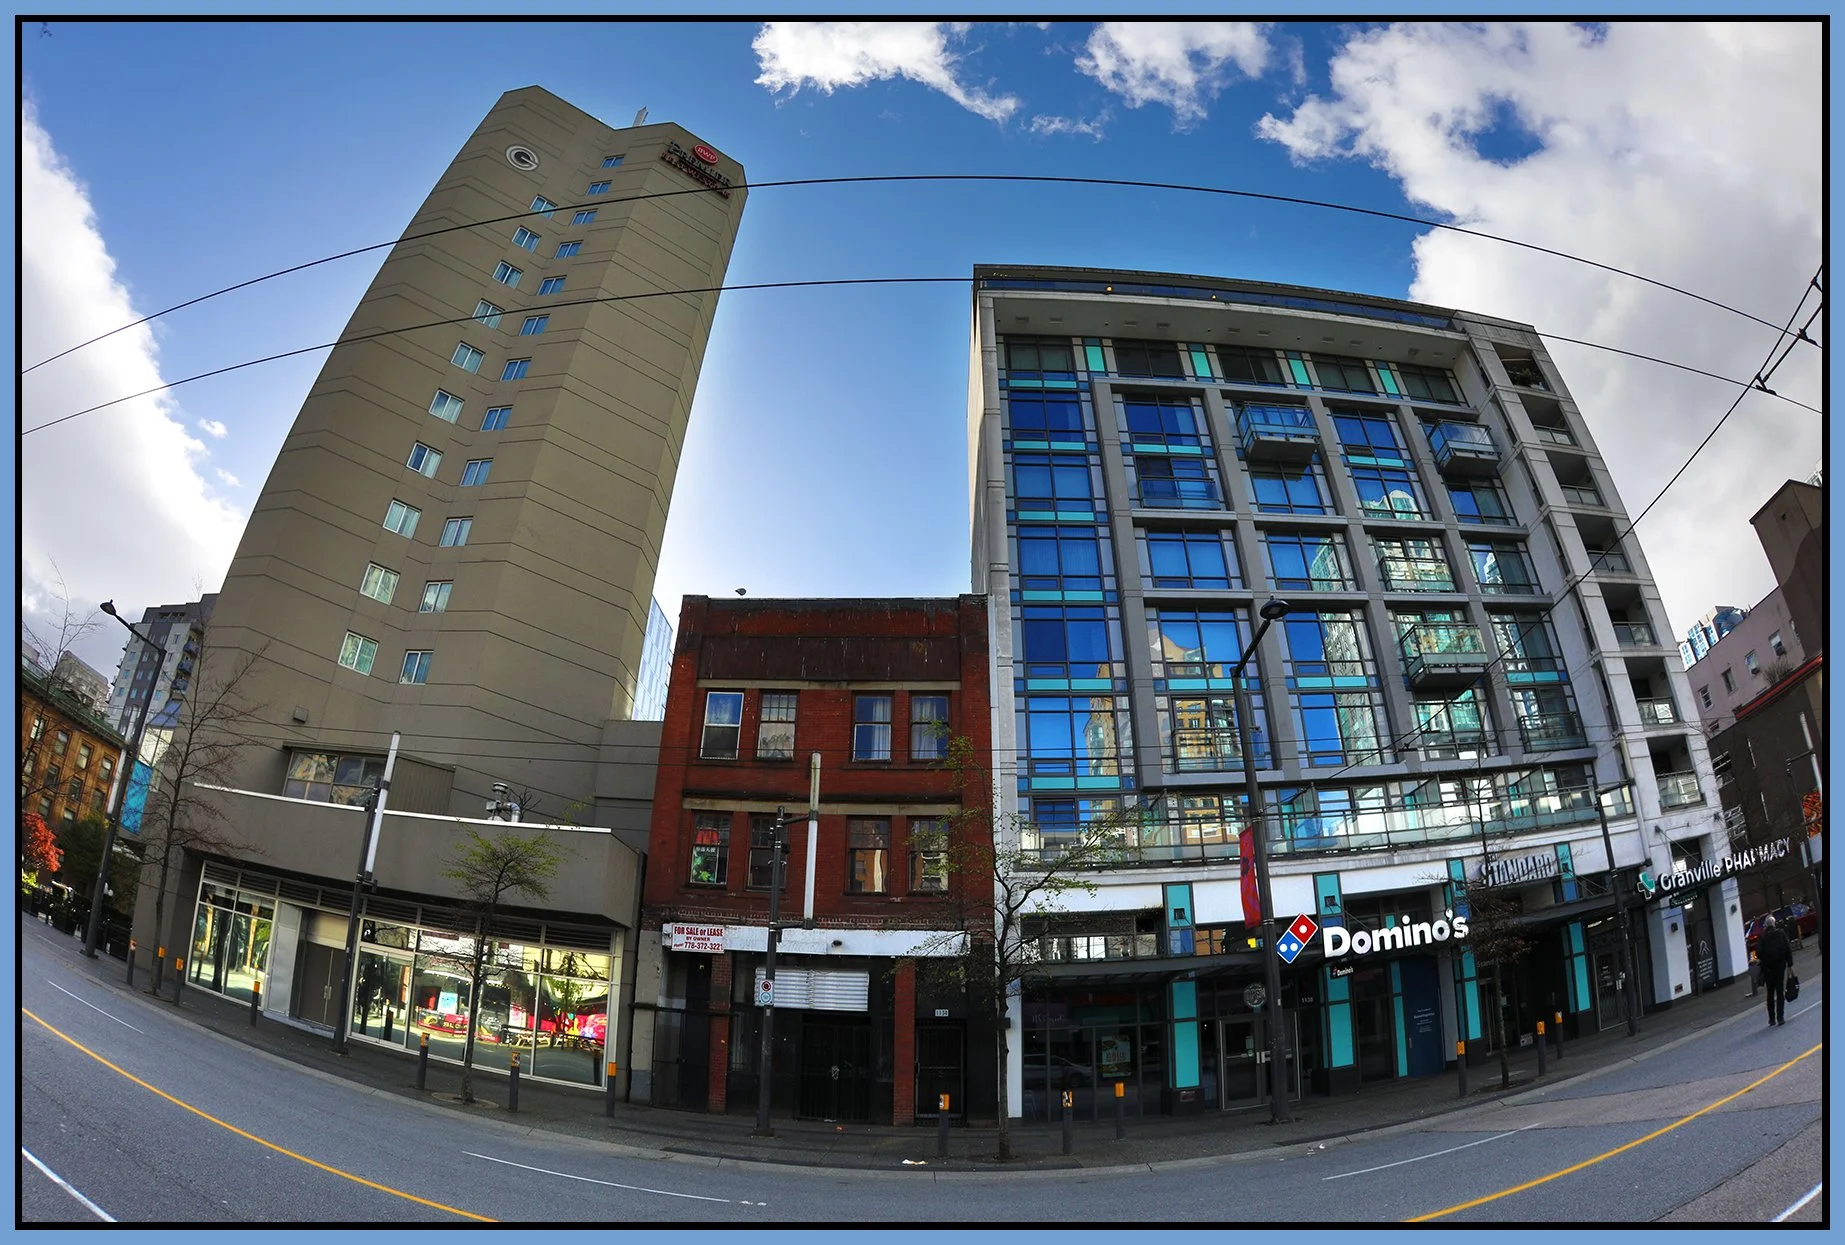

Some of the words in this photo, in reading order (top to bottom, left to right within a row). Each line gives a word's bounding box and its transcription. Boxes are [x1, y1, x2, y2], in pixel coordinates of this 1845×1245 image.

[1480, 854, 1555, 887] STANDARD
[1660, 860, 1721, 891] Granville
[674, 926, 685, 935] FOR
[686, 927, 699, 936] SALE
[707, 928, 723, 937] LEASE
[1323, 908, 1469, 958] Domino's
